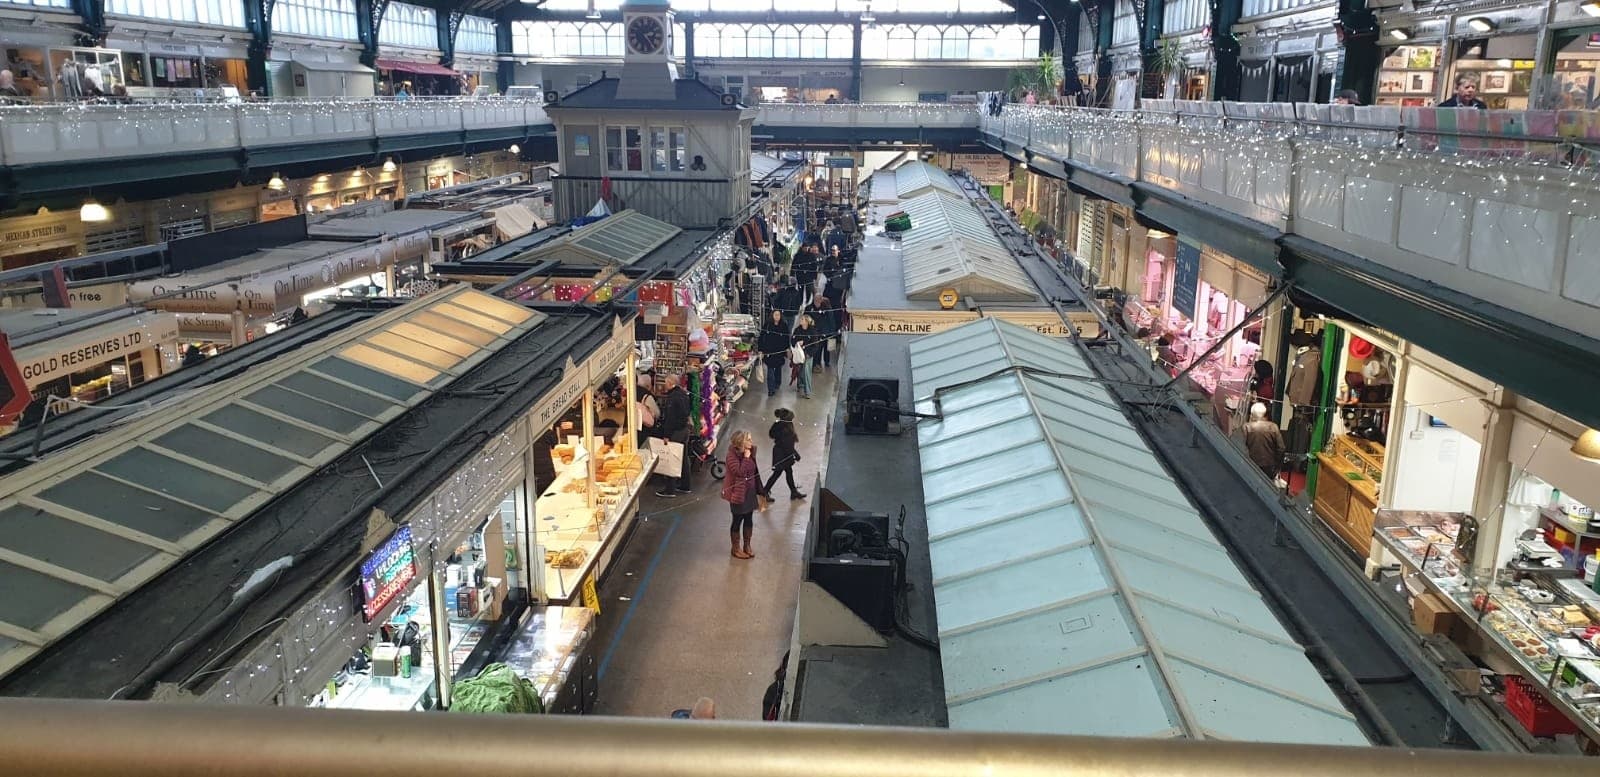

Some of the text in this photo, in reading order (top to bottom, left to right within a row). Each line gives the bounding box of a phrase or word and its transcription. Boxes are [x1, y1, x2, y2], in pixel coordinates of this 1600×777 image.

[5, 230, 30, 241] MEXICAN
[32, 226, 52, 238] STREET
[336, 257, 369, 276] On Time
[275, 274, 314, 295] On Time
[79, 292, 102, 301] free
[244, 290, 261, 300] On
[183, 317, 193, 326] &
[195, 317, 225, 329] Straps
[867, 324, 931, 332] J. S. CARLINE
[1059, 325, 1082, 334] 195
[23, 357, 58, 380] GOLD
[61, 338, 120, 368] RESERVES
[123, 331, 142, 348] LTD
[541, 379, 581, 424] THE BREAD STALL
